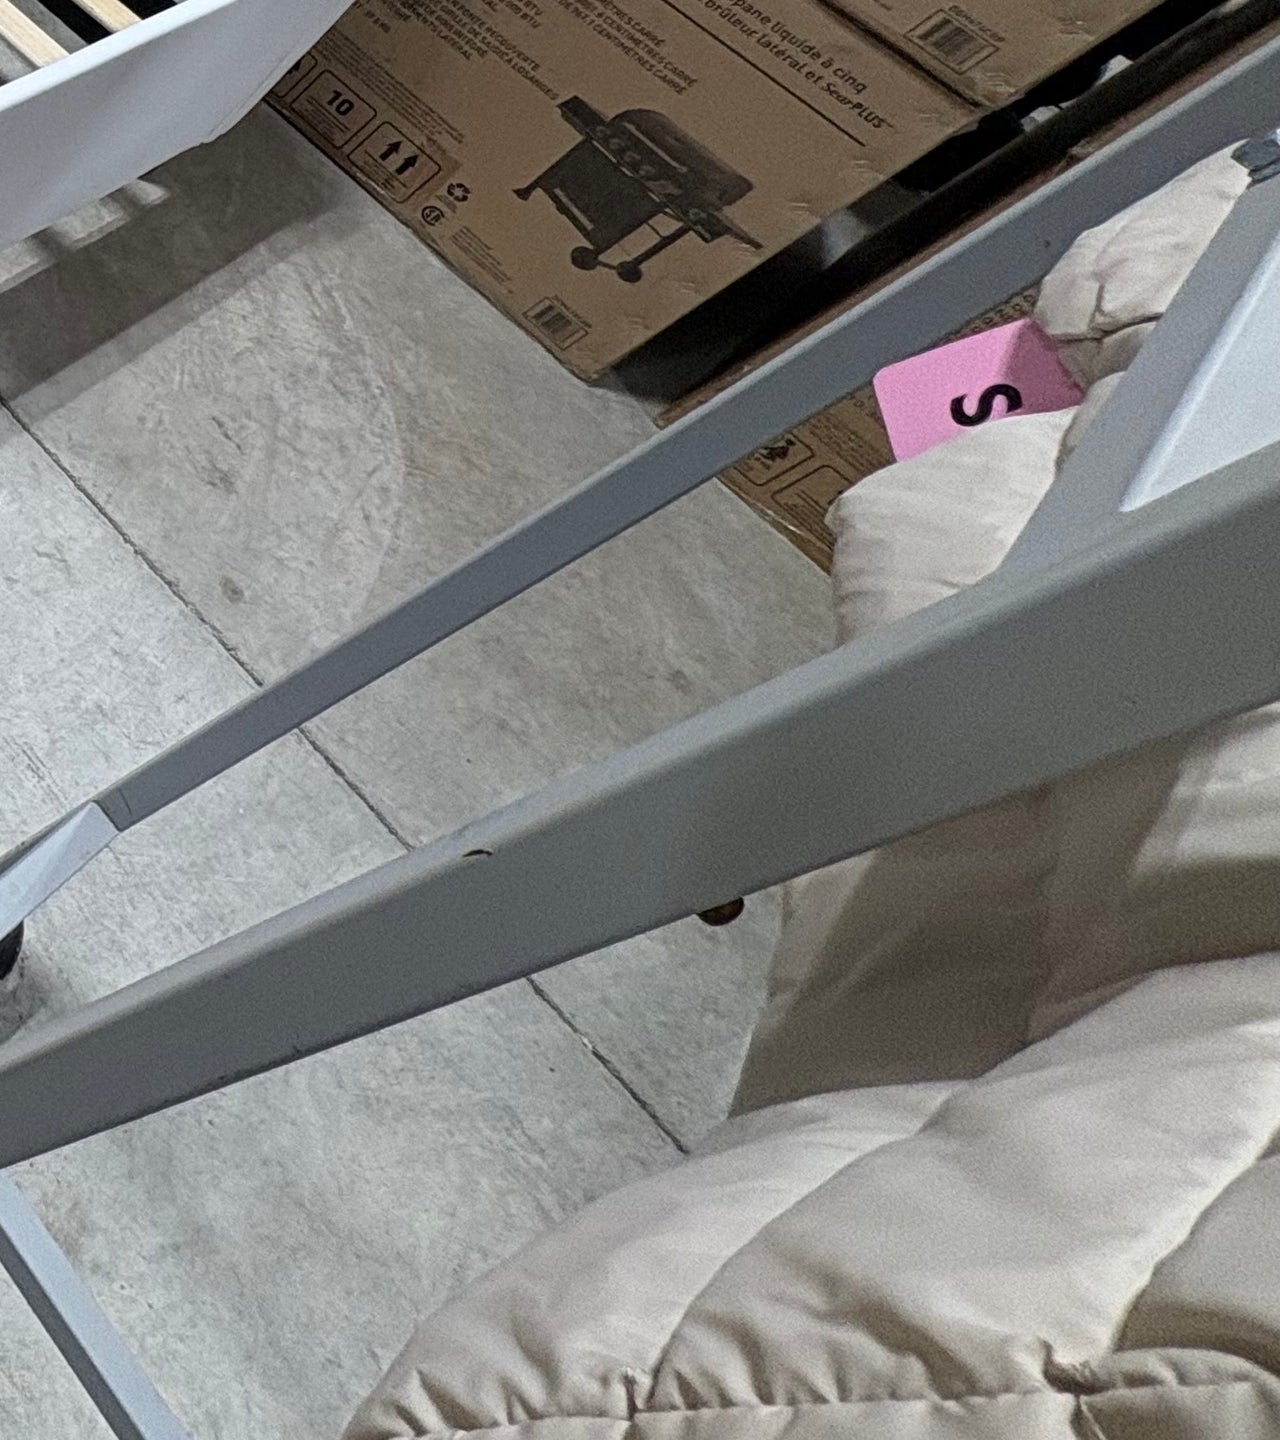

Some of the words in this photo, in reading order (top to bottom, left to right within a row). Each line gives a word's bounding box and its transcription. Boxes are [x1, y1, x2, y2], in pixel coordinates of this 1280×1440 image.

[754, 32, 809, 75] latéral
[803, 67, 824, 86] et
[768, 20, 823, 64] liquide
[829, 64, 868, 96] cinq
[324, 88, 355, 118] 10
